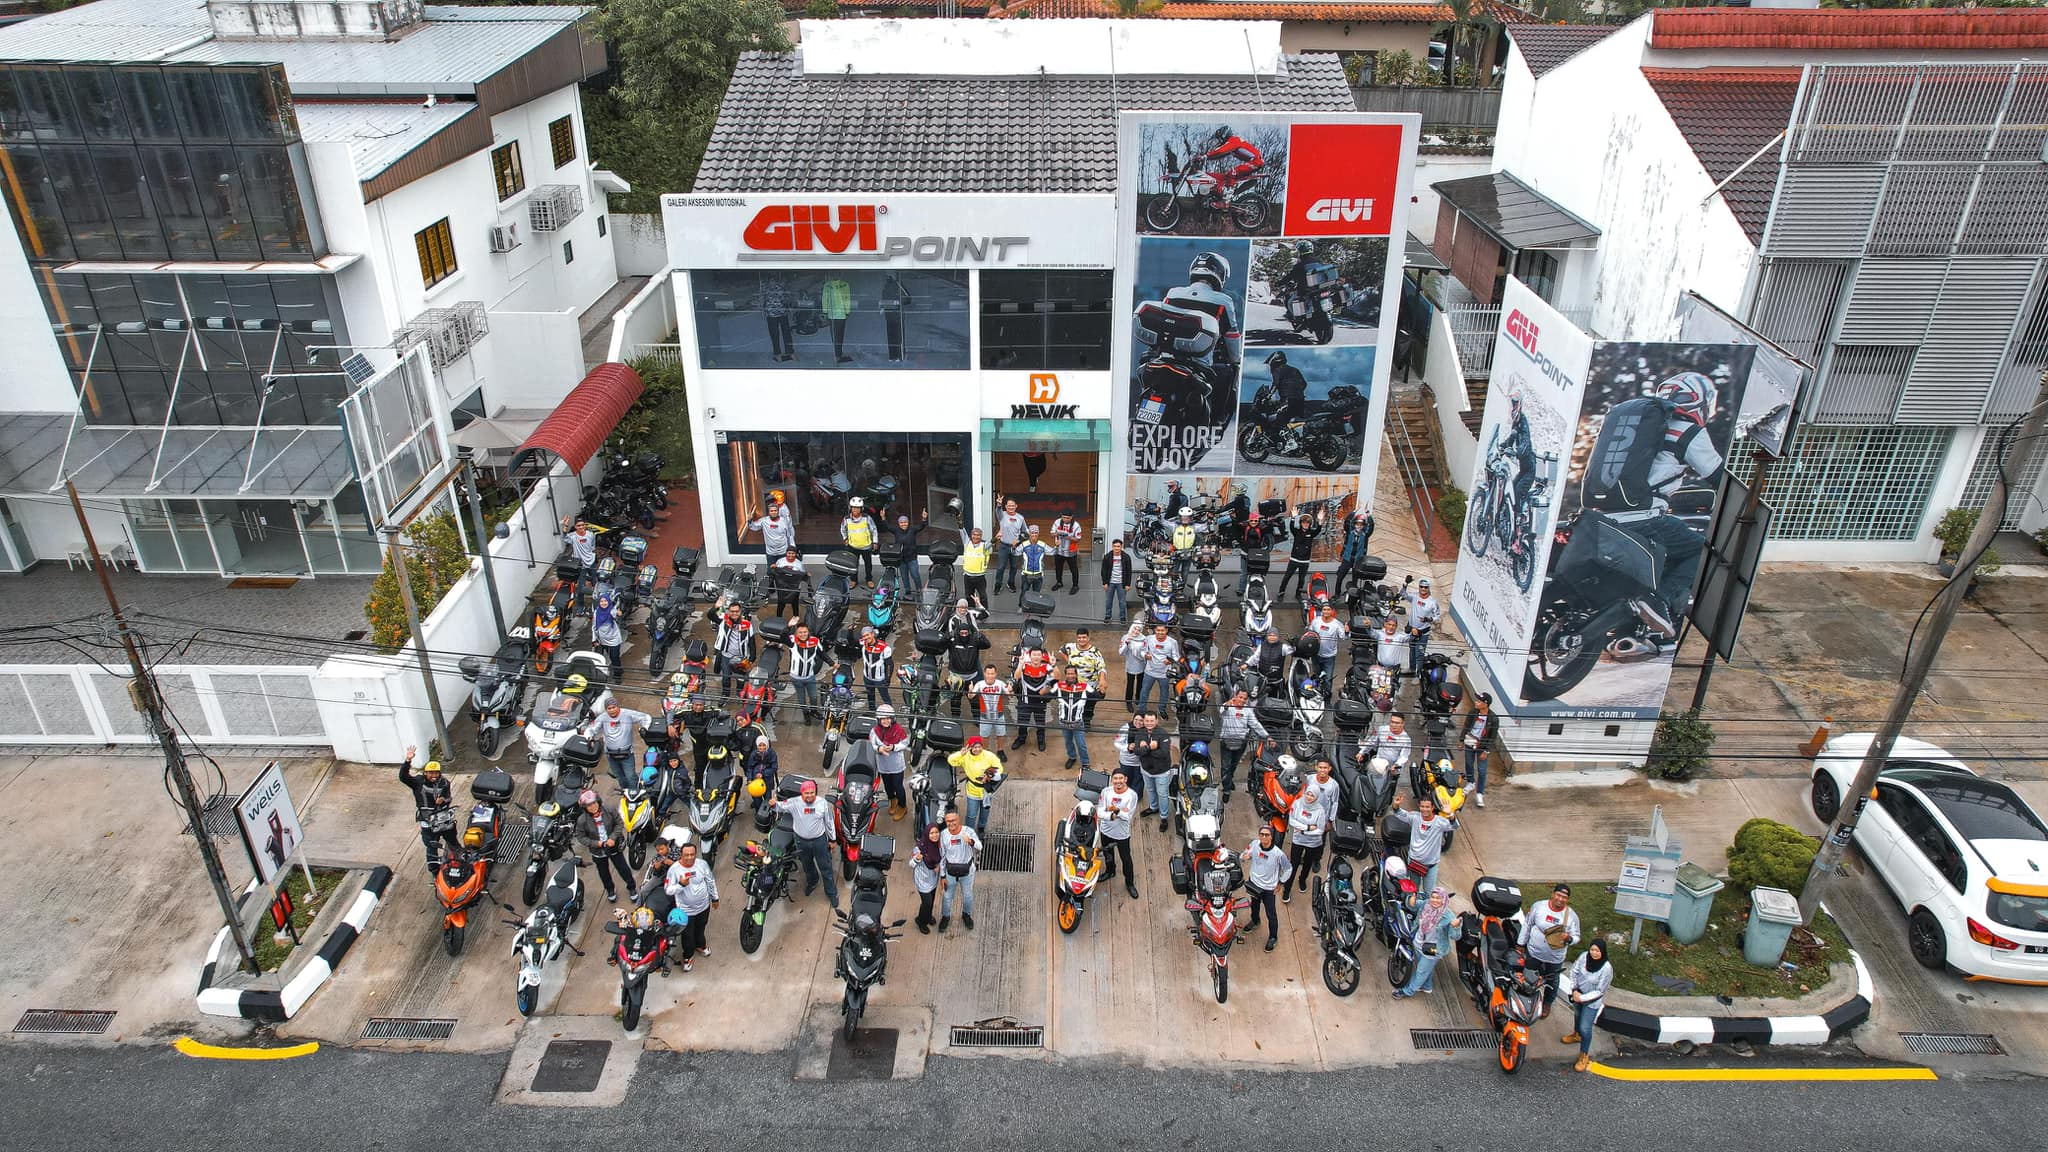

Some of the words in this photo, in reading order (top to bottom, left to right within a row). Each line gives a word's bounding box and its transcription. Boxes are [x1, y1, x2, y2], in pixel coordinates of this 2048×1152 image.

[667, 198, 687, 207] GALERI
[688, 198, 715, 207] AKSESORI
[716, 198, 746, 207] MOTOSIKAL
[1306, 198, 1375, 222] GIVI
[743, 205, 877, 253] GIVI
[884, 236, 1030, 262] POINT
[1506, 308, 1539, 355] GIVI
[1535, 350, 1574, 392] POINT
[1011, 404, 1076, 419] HEVIK
[1133, 447, 1196, 471] ENJOY.
[1551, 708, 1637, 720] www.givi.com.my
[248, 780, 281, 820] wells
